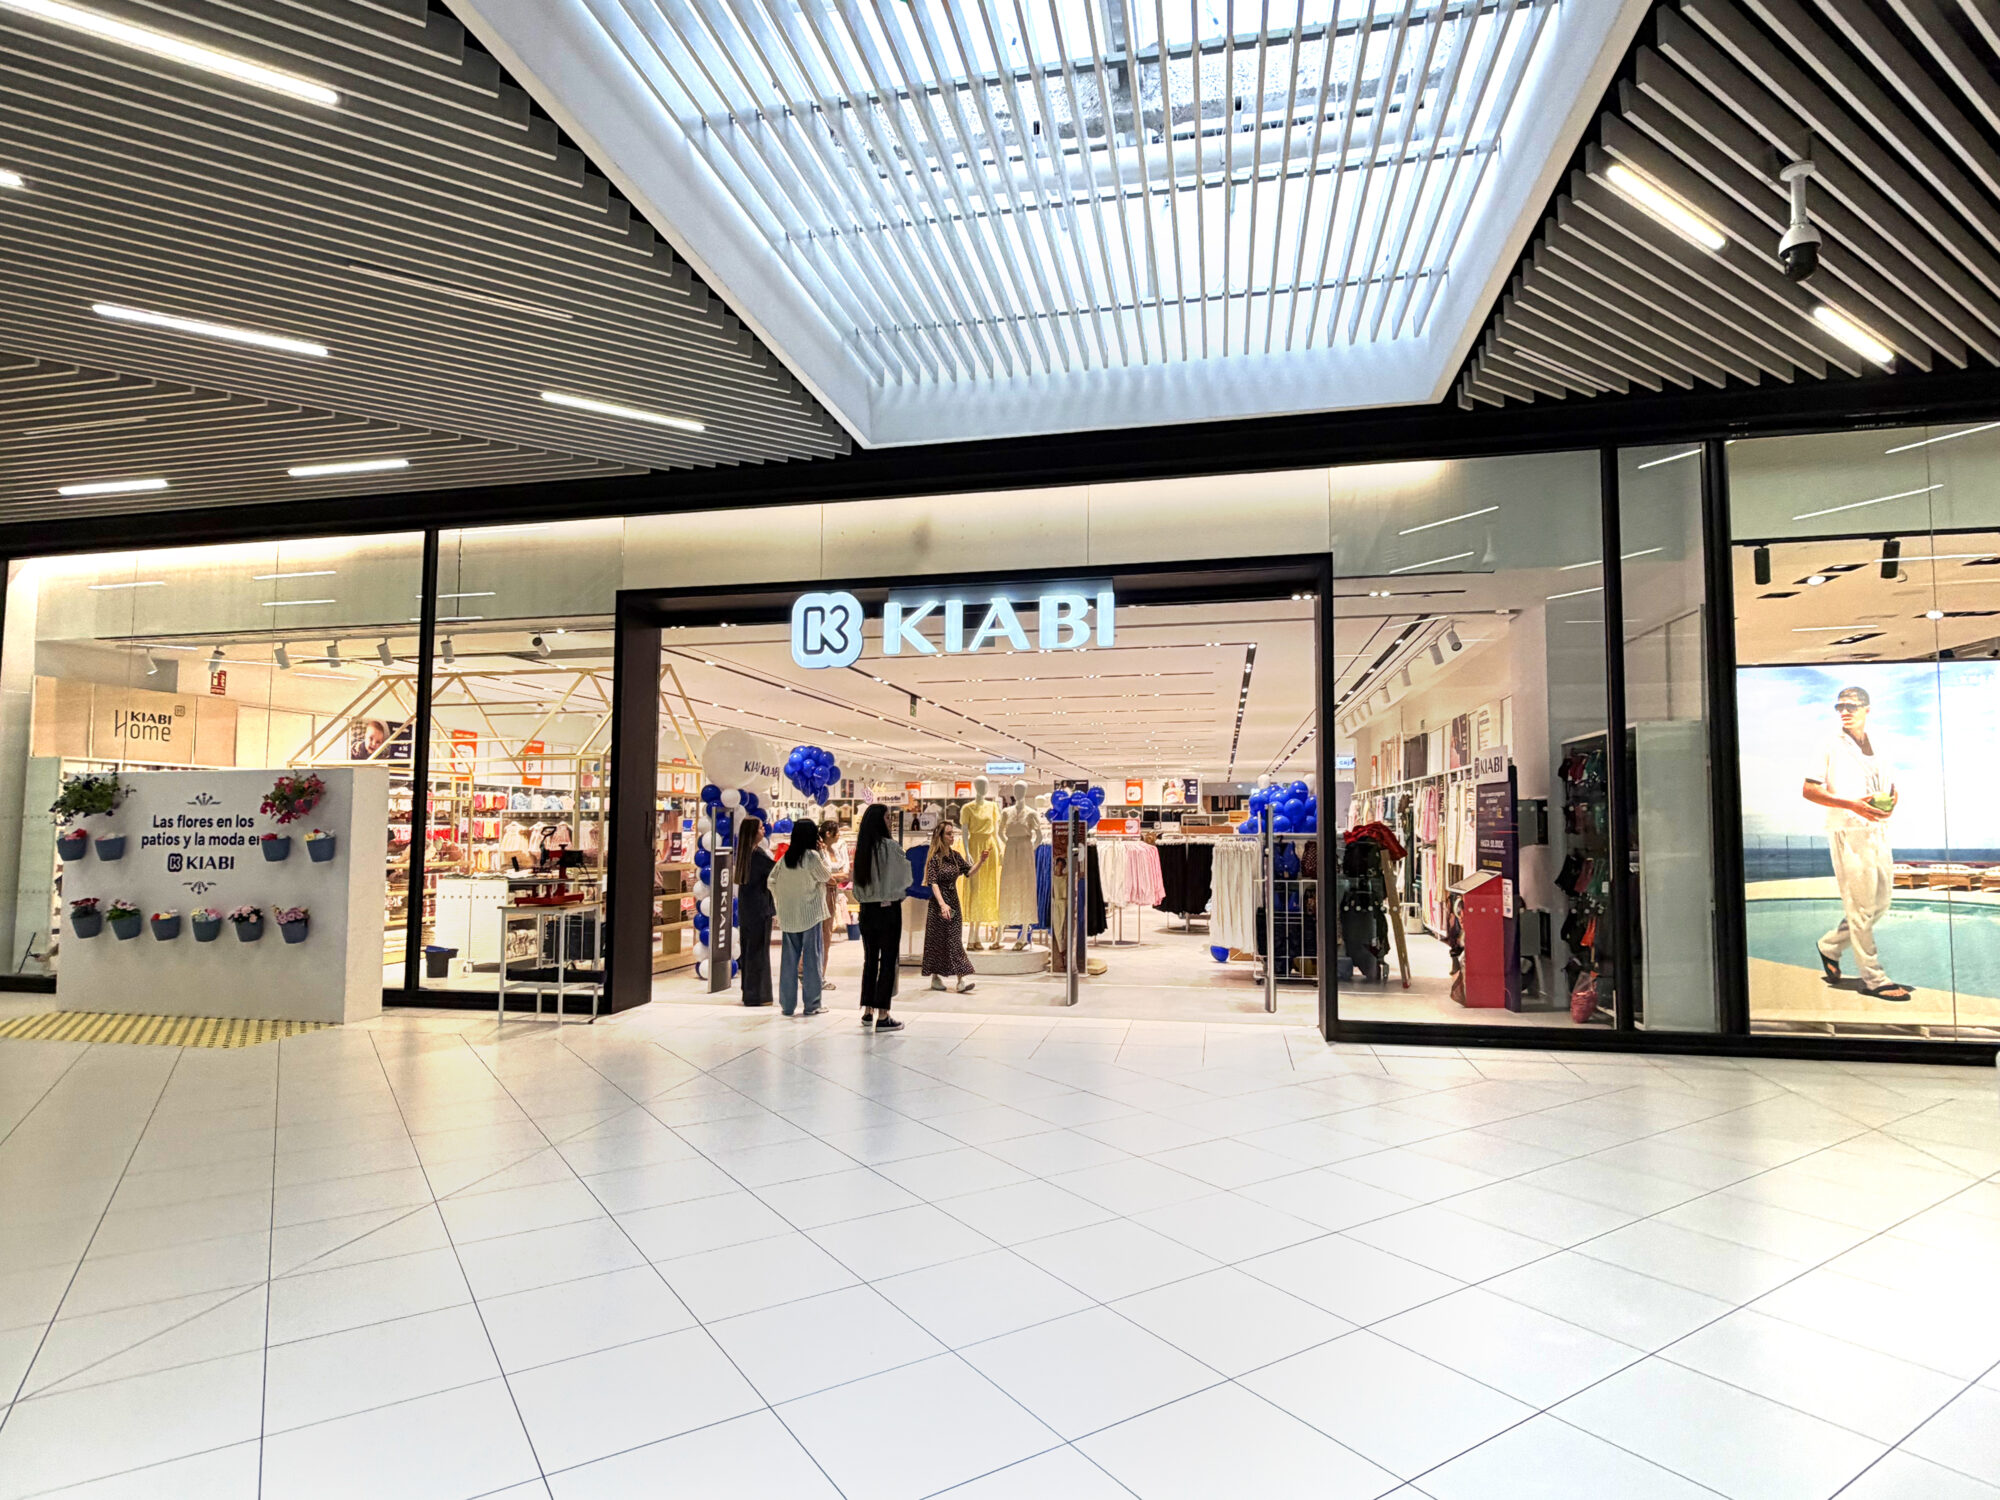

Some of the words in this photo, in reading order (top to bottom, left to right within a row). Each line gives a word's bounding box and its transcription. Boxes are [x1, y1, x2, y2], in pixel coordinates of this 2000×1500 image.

[883, 592, 1115, 655] KIABI
[114, 709, 172, 742] Home
[130, 711, 172, 725] KIABI
[1480, 756, 1503, 774] KIABI
[153, 815, 174, 828] Las
[177, 814, 213, 828] flores
[216, 817, 232, 828] en
[235, 814, 254, 828] los
[141, 832, 180, 849] patios
[183, 835, 192, 849] y
[194, 832, 205, 846] la
[208, 832, 245, 846] moda
[186, 856, 235, 870] KIABI
[718, 891, 728, 949] KIABI
